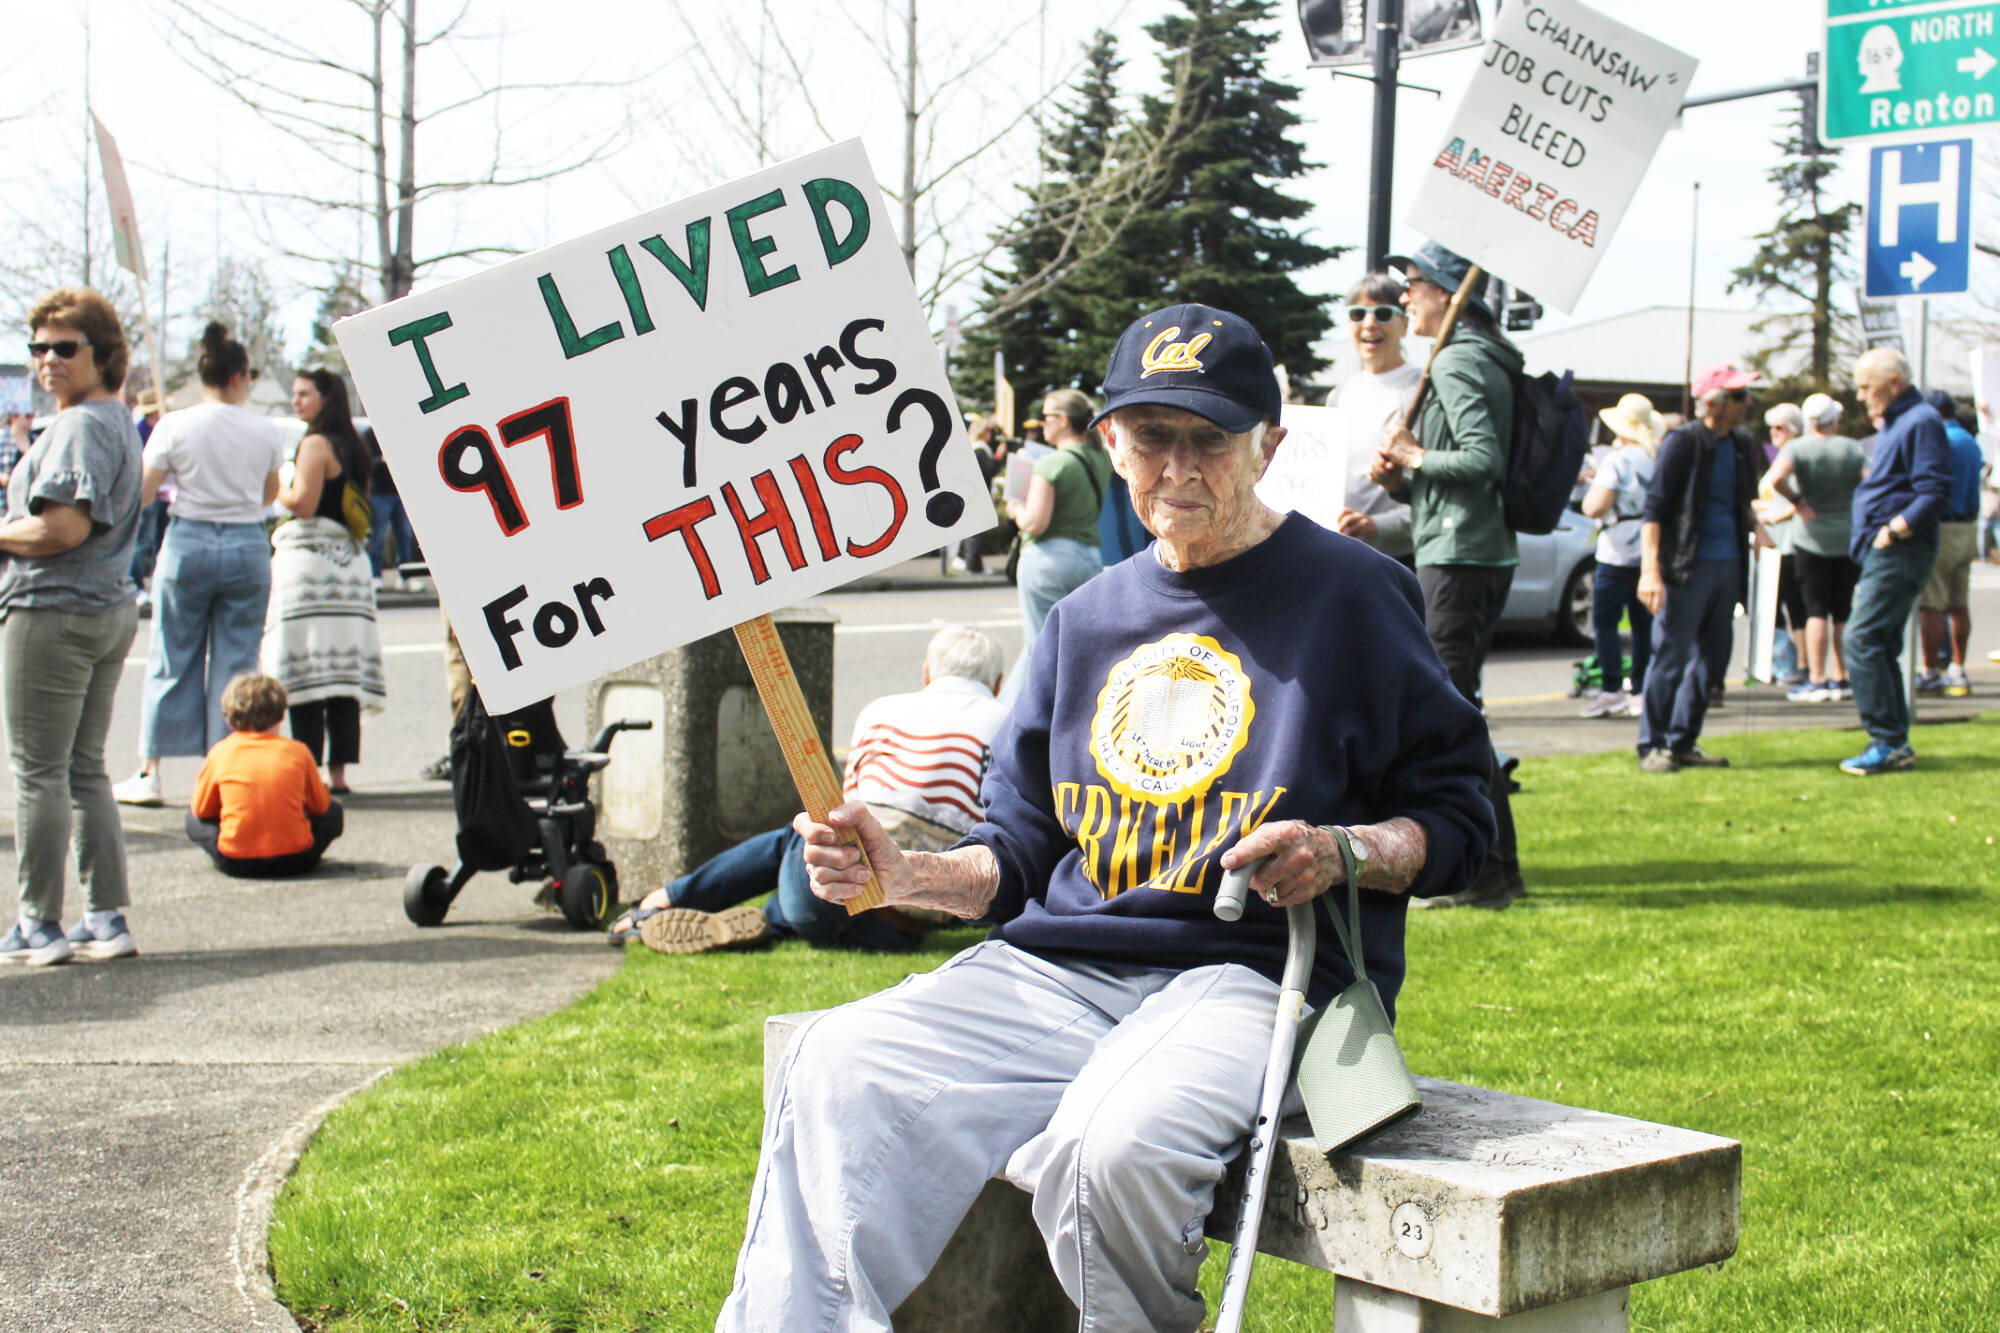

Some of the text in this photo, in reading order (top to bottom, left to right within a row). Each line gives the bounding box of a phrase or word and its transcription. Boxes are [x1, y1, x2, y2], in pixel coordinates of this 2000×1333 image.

[1911, 11, 1994, 44] NORTH
[1484, 39, 1613, 122] JOB CUTS
[1870, 91, 1994, 128] Renton
[1500, 103, 1586, 168] BLEED
[1433, 136, 1600, 248] AMERICA
[1878, 144, 1961, 247] H
[388, 178, 872, 414] I LIVED
[1140, 326, 1212, 379] Cal
[438, 318, 898, 537] 97 years
[482, 388, 965, 672] For THIS?
[754, 614, 790, 681] THE HO
[1099, 732, 1114, 764] THE
[1189, 645, 1214, 662] OF
[1203, 667, 1240, 768] CALIFORNIA
[1132, 732, 1207, 768] LET THERE BE LIGHT
[1052, 782, 1288, 901] ERKELEY
[1402, 1222, 1423, 1240] 23
